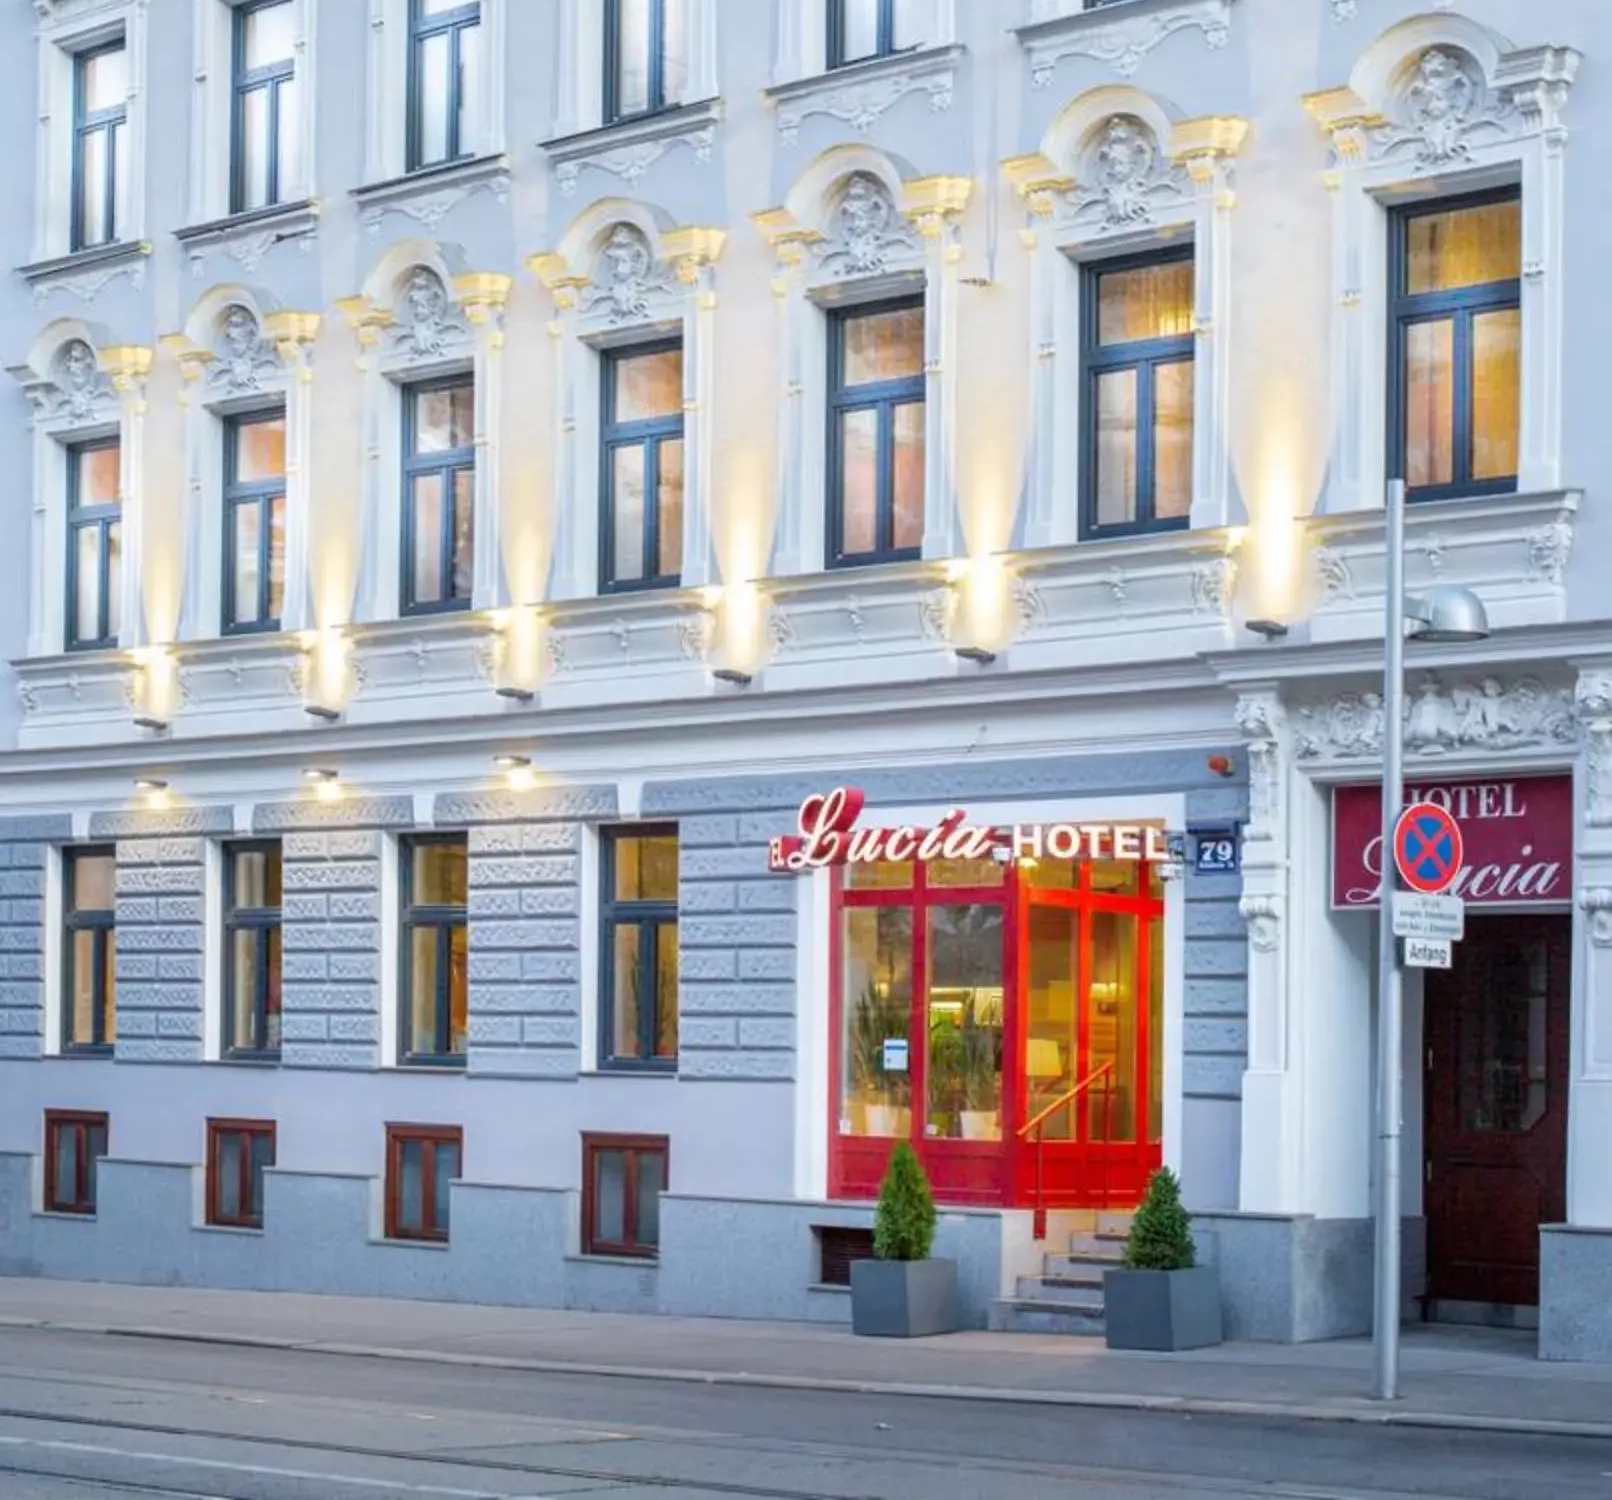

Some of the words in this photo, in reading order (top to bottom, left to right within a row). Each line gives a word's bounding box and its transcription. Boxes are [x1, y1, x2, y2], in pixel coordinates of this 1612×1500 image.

[1013, 823, 1169, 861] HOTEL
[1199, 840, 1233, 861] 79
[1409, 943, 1448, 965] Anfang
